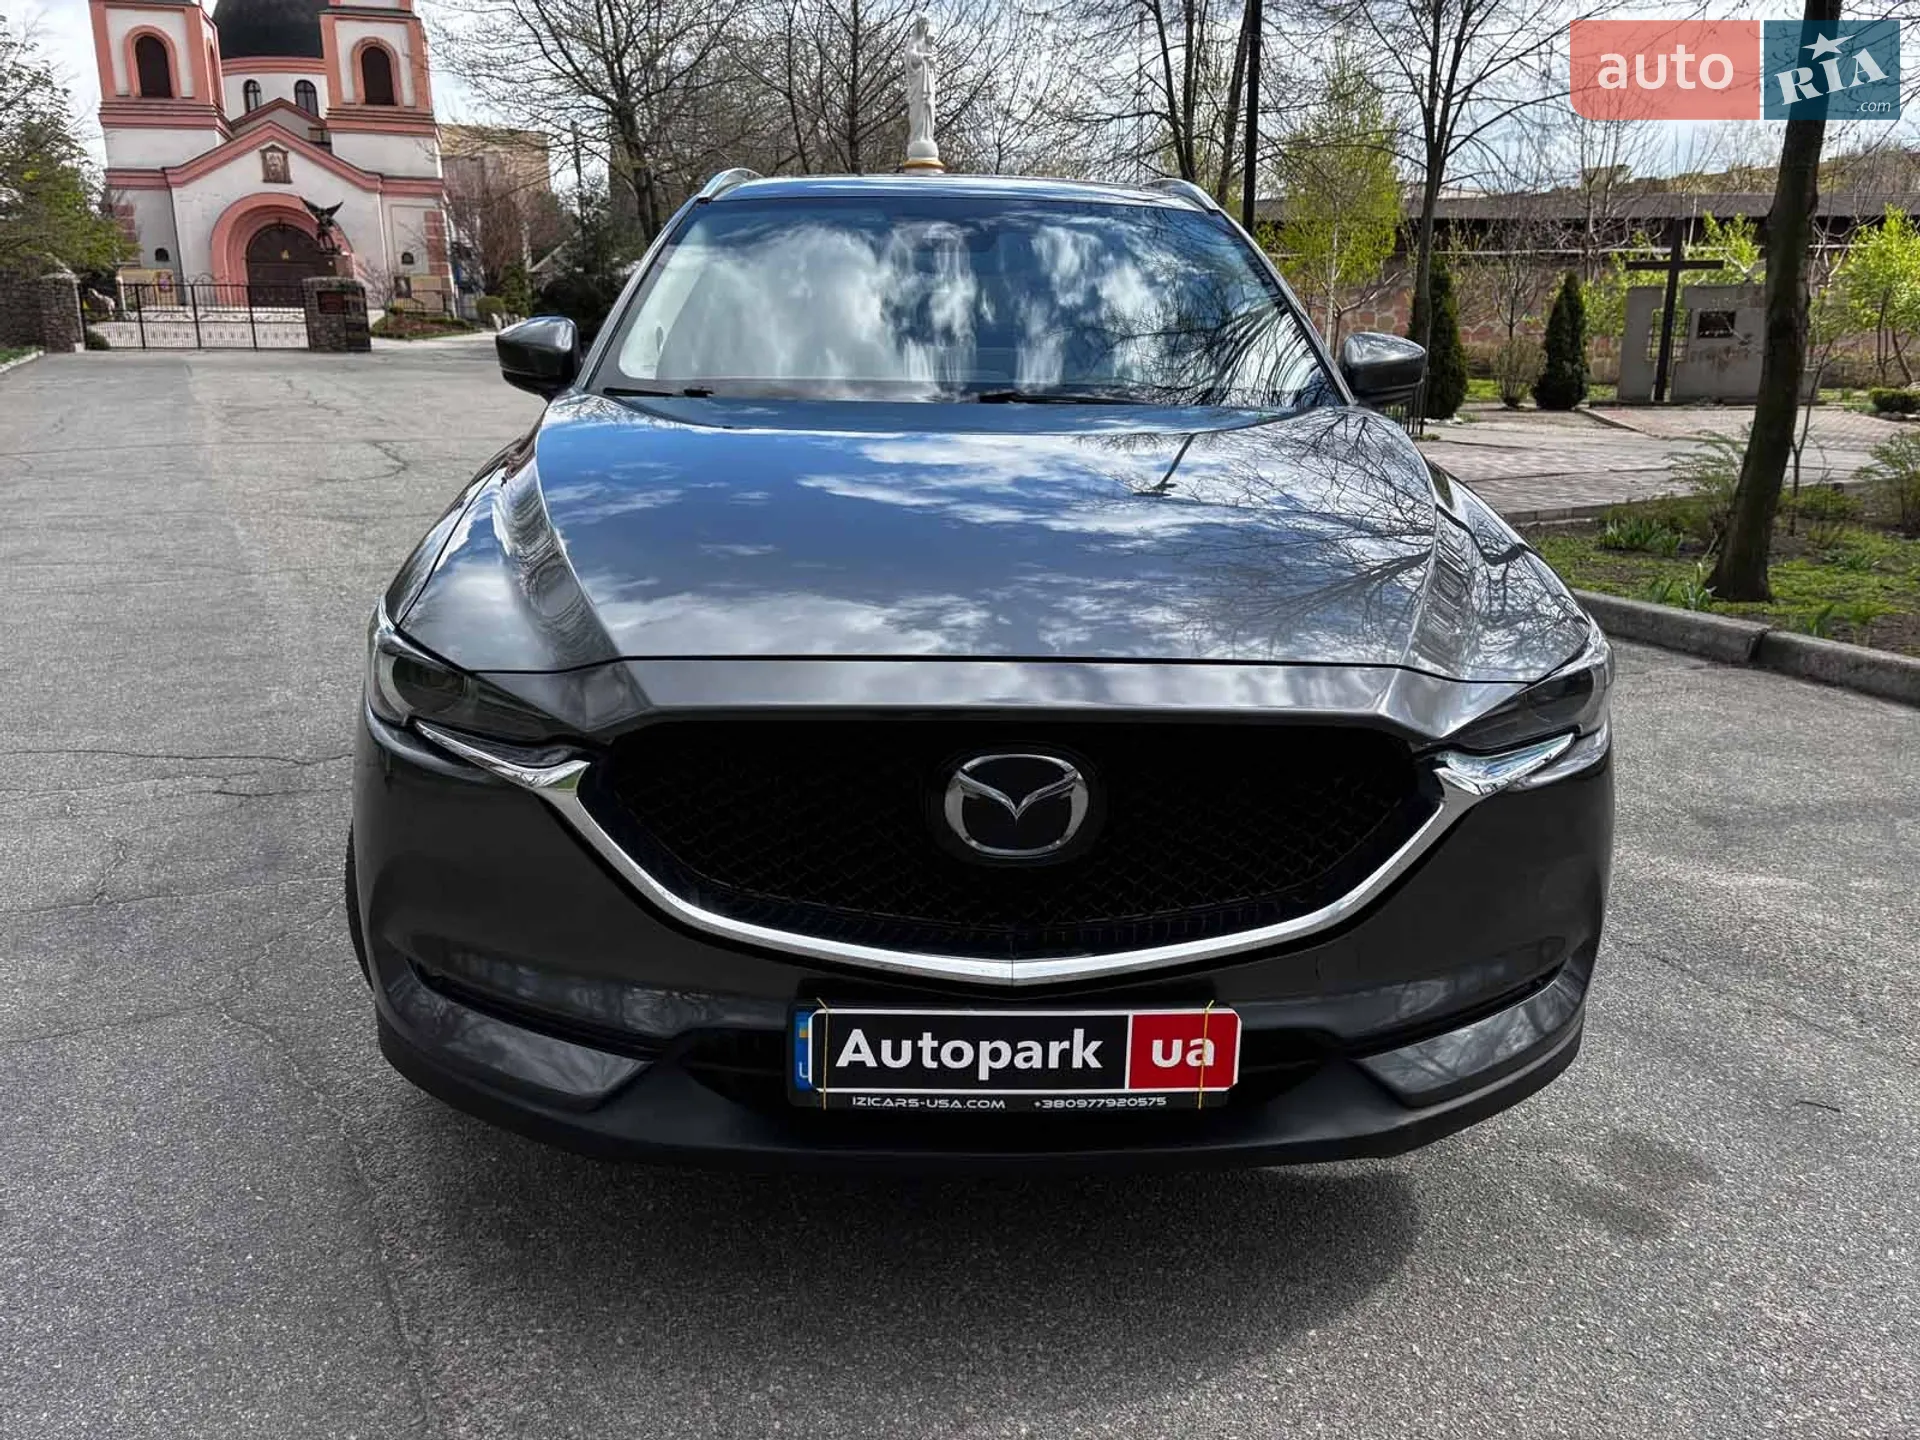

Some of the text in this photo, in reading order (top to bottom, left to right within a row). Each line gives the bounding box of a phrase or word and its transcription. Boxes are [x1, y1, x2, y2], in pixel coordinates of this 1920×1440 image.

[835, 1028, 1103, 1081] Autopark
[1151, 1037, 1216, 1068] ua
[852, 1096, 1167, 1110] IZICARS-USA.COM +380977920575
